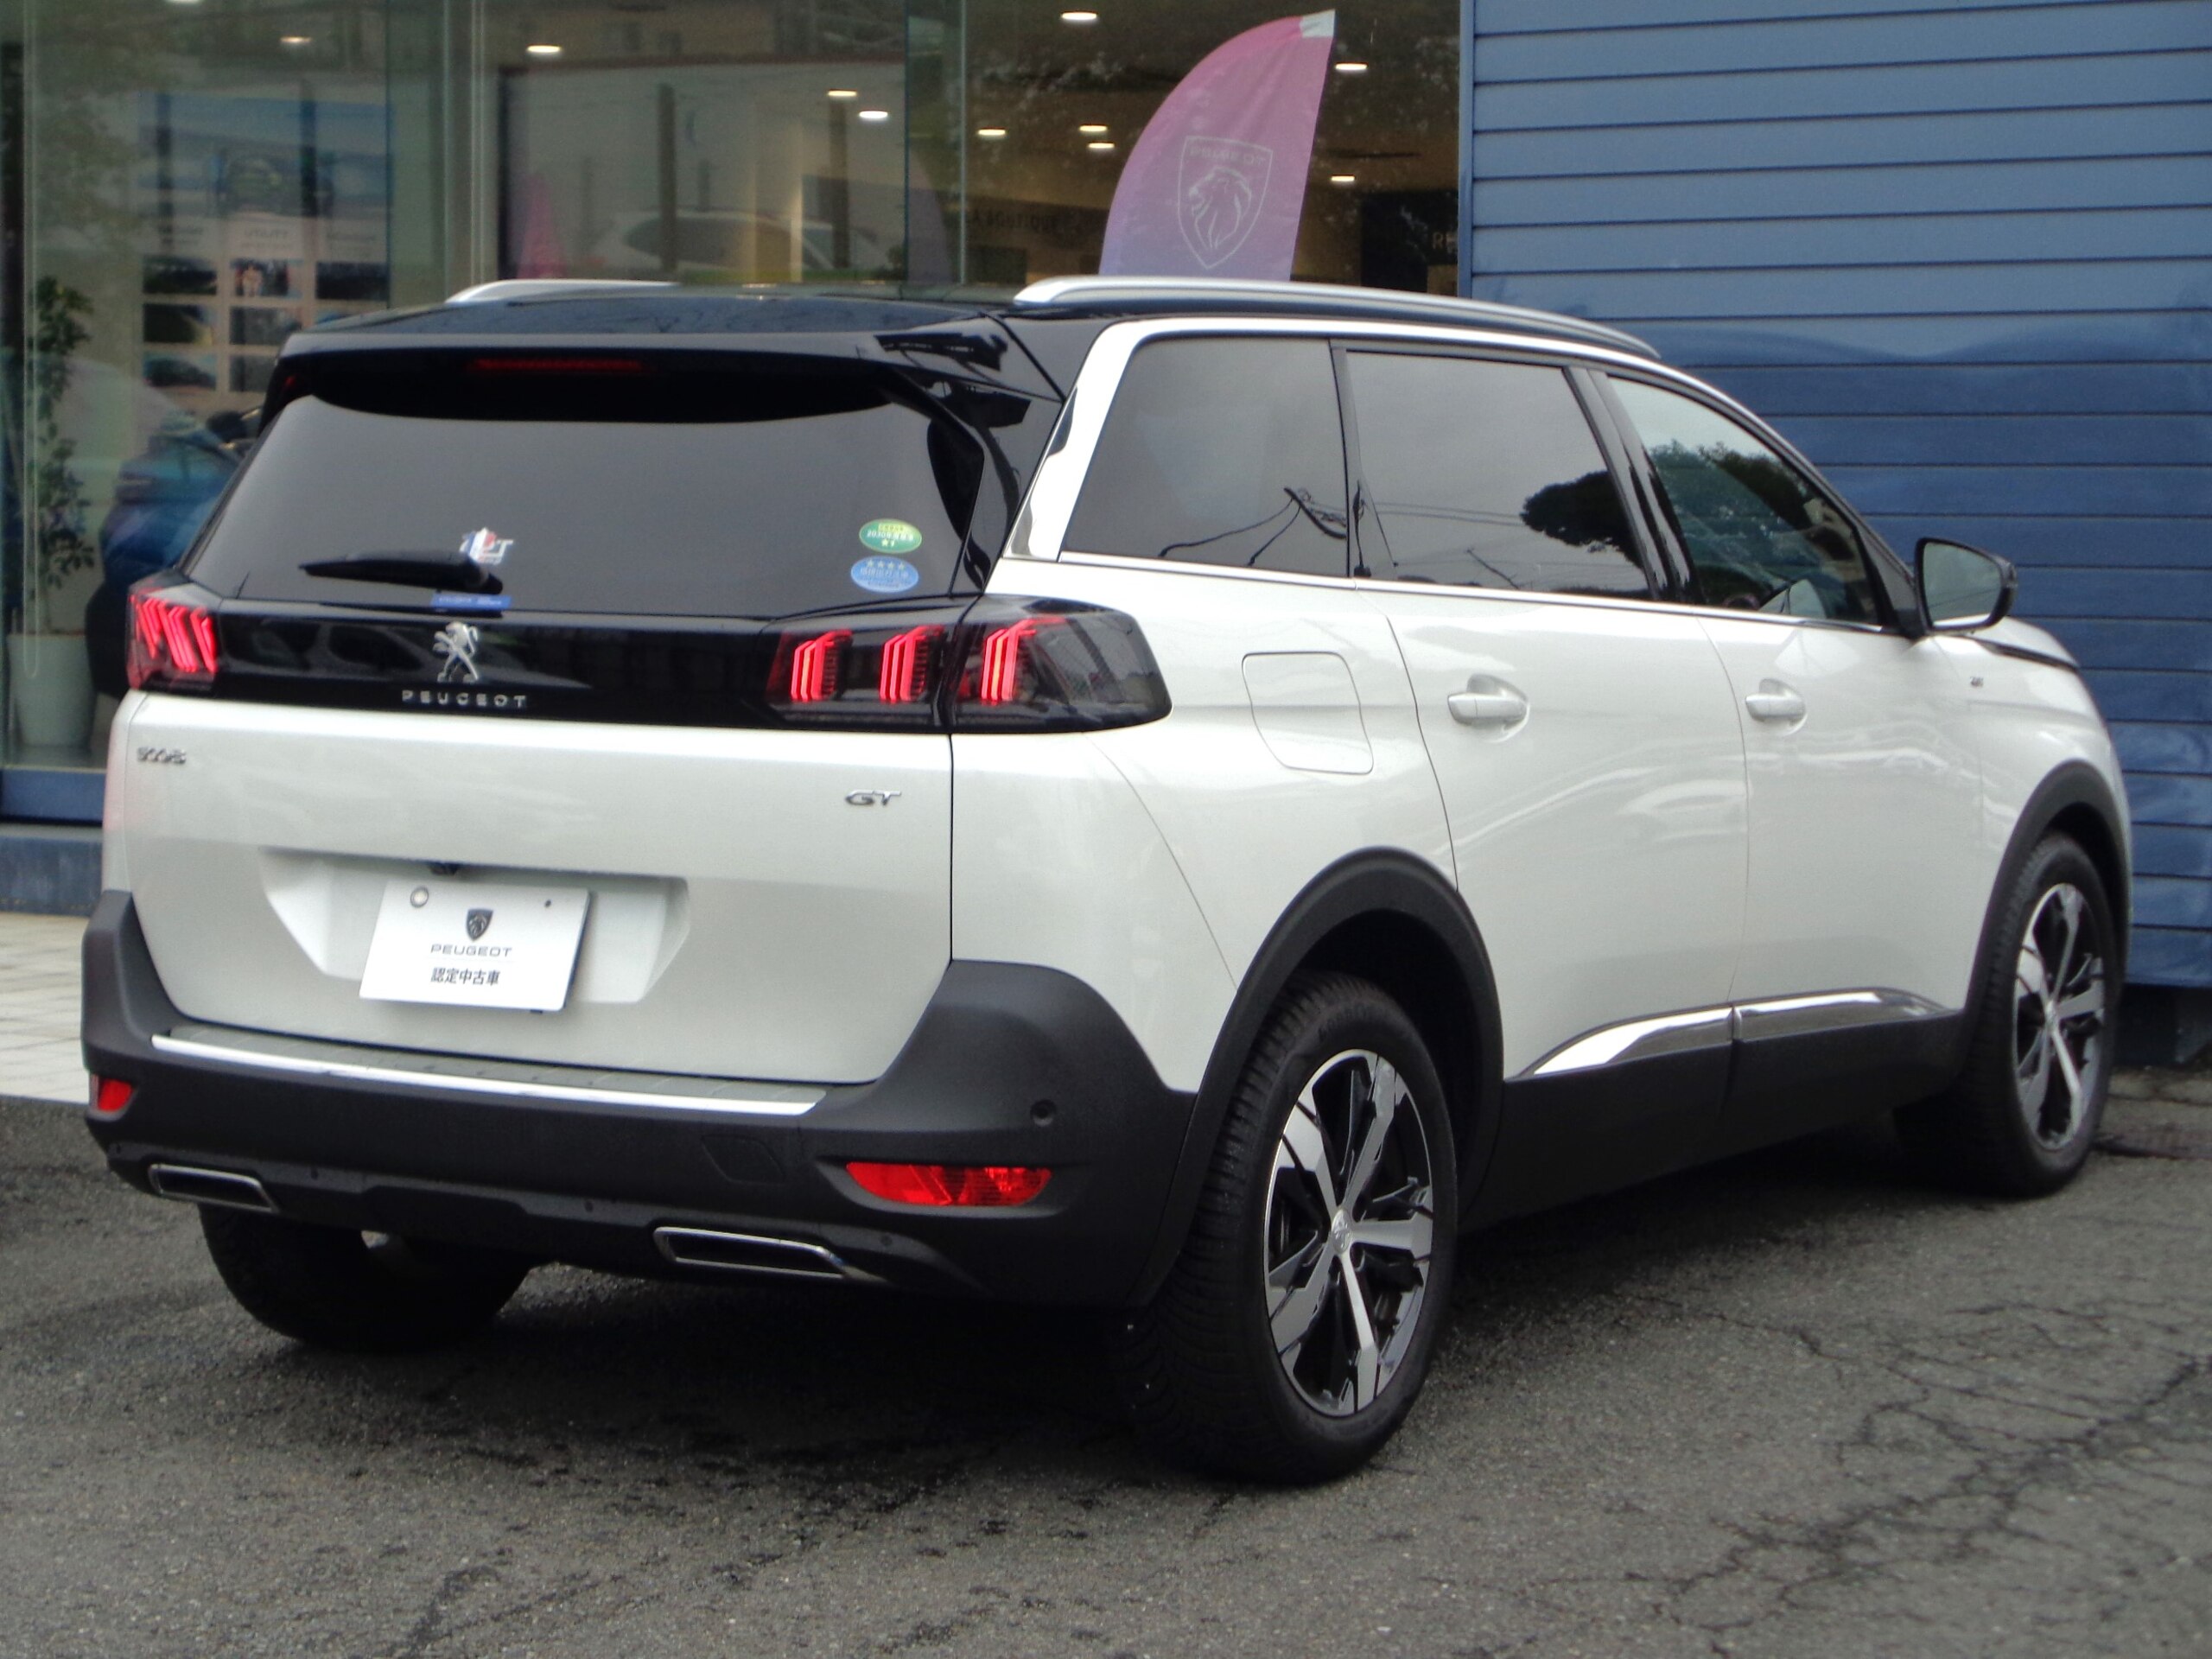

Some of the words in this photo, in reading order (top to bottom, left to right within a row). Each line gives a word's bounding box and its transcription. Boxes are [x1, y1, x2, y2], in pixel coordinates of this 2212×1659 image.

[402, 690, 526, 708] PEUGEOT
[845, 790, 901, 805] GT
[430, 944, 512, 957] PEUGEOT
[430, 967, 500, 986] 認定中古車
